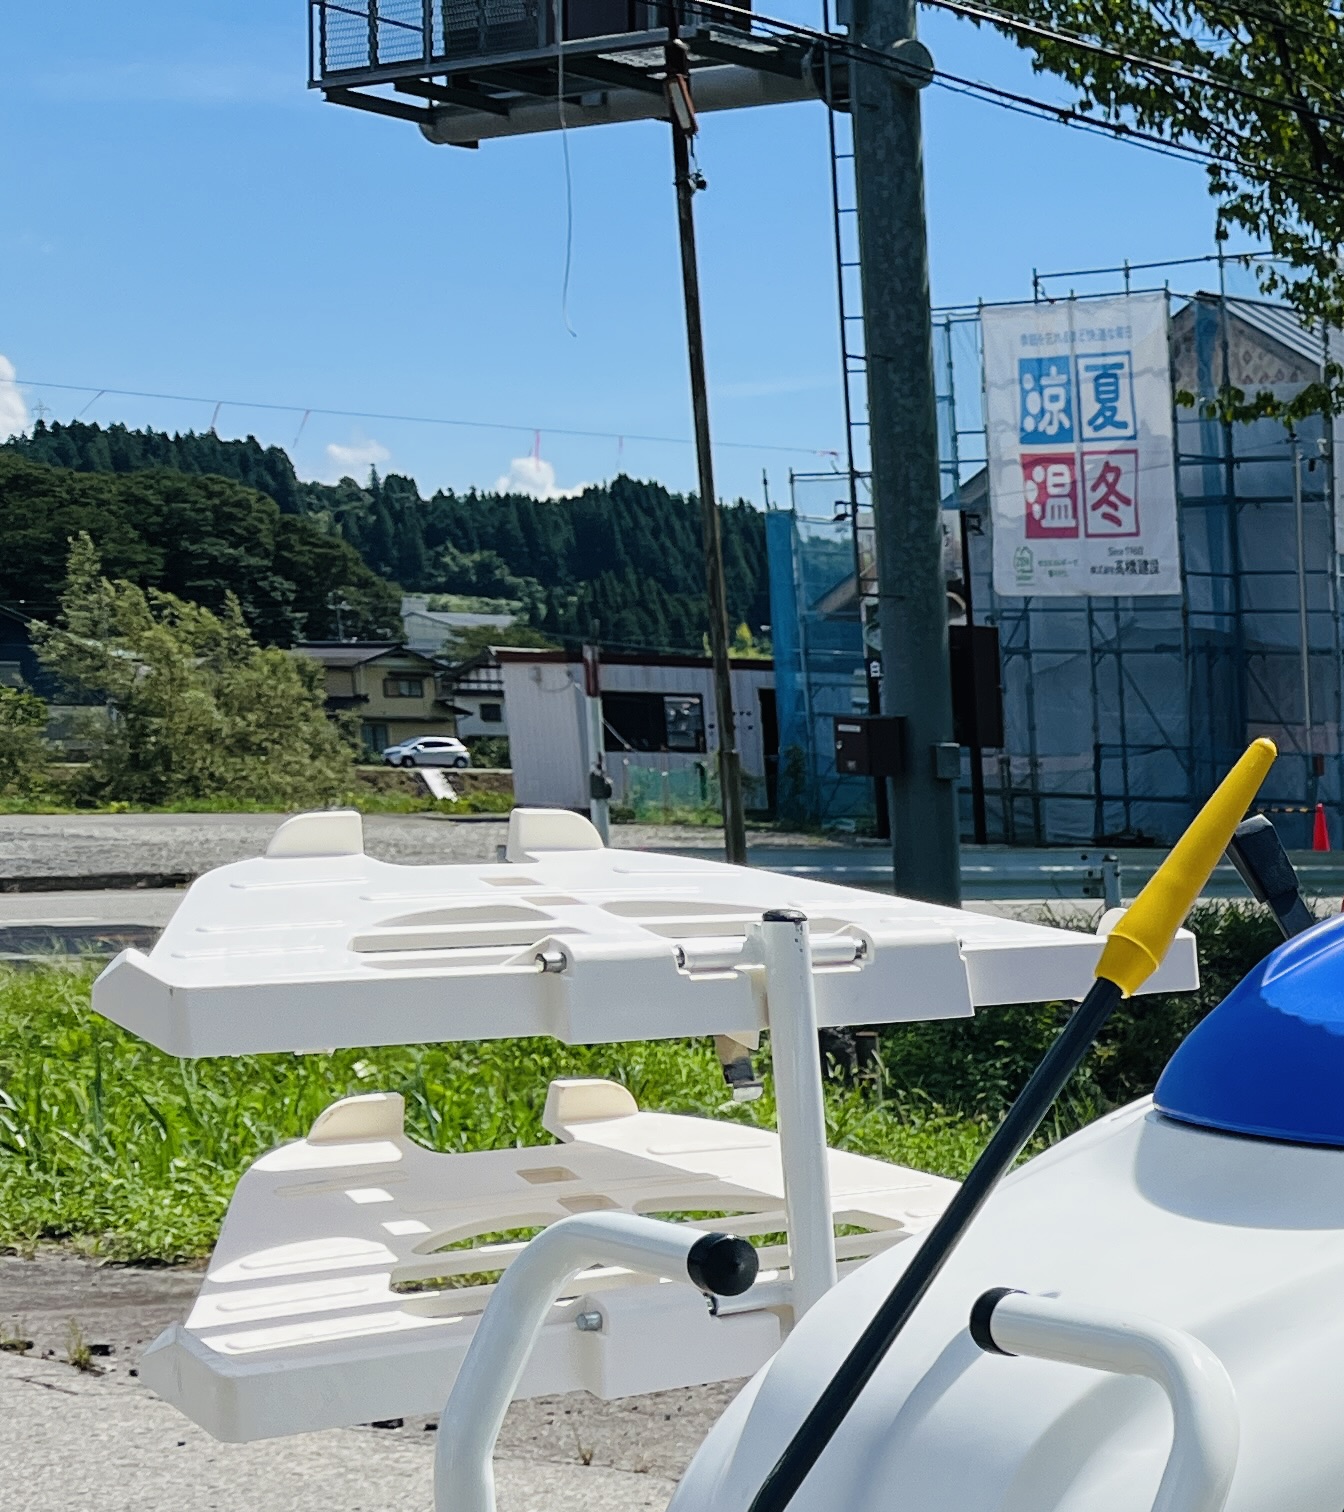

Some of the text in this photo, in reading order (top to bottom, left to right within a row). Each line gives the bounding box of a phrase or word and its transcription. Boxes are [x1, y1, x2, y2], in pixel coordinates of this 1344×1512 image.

[1022, 366, 1070, 436] 涼
[1086, 361, 1128, 432] 夏
[1026, 463, 1079, 529] 温
[1090, 459, 1133, 528] 冬
